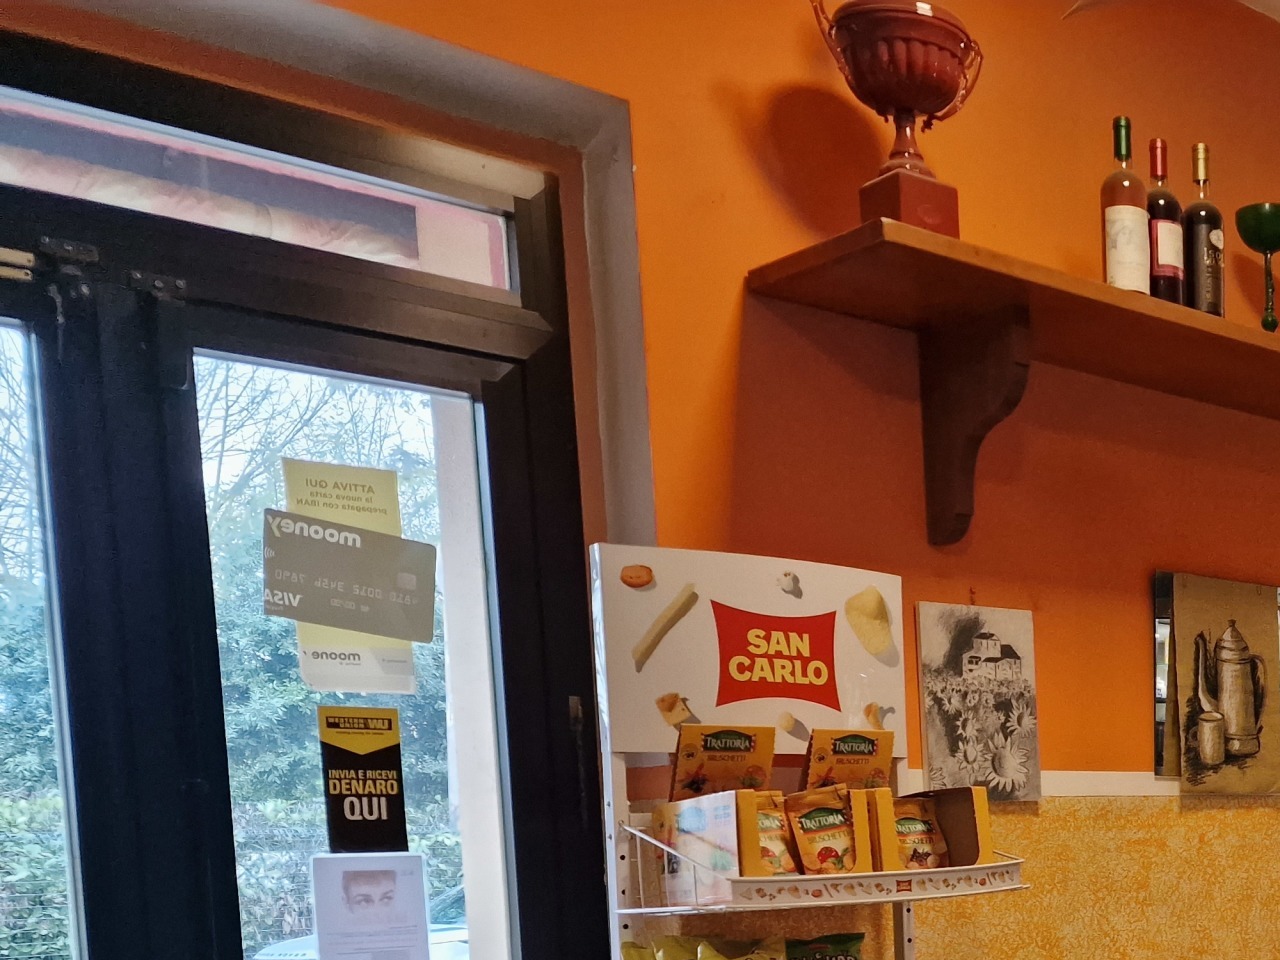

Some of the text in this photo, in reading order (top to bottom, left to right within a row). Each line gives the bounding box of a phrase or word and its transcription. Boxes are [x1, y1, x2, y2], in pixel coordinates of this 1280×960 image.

[746, 628, 810, 657] SAN
[728, 655, 828, 686] CARLO
[705, 735, 751, 750] TRATTORIA
[835, 740, 874, 754] TRATTORIA
[329, 770, 397, 780] INVIA E RICEVI
[329, 779, 398, 795] DENARO
[343, 796, 388, 821] QUI
[800, 812, 844, 829] TRATTORIA
